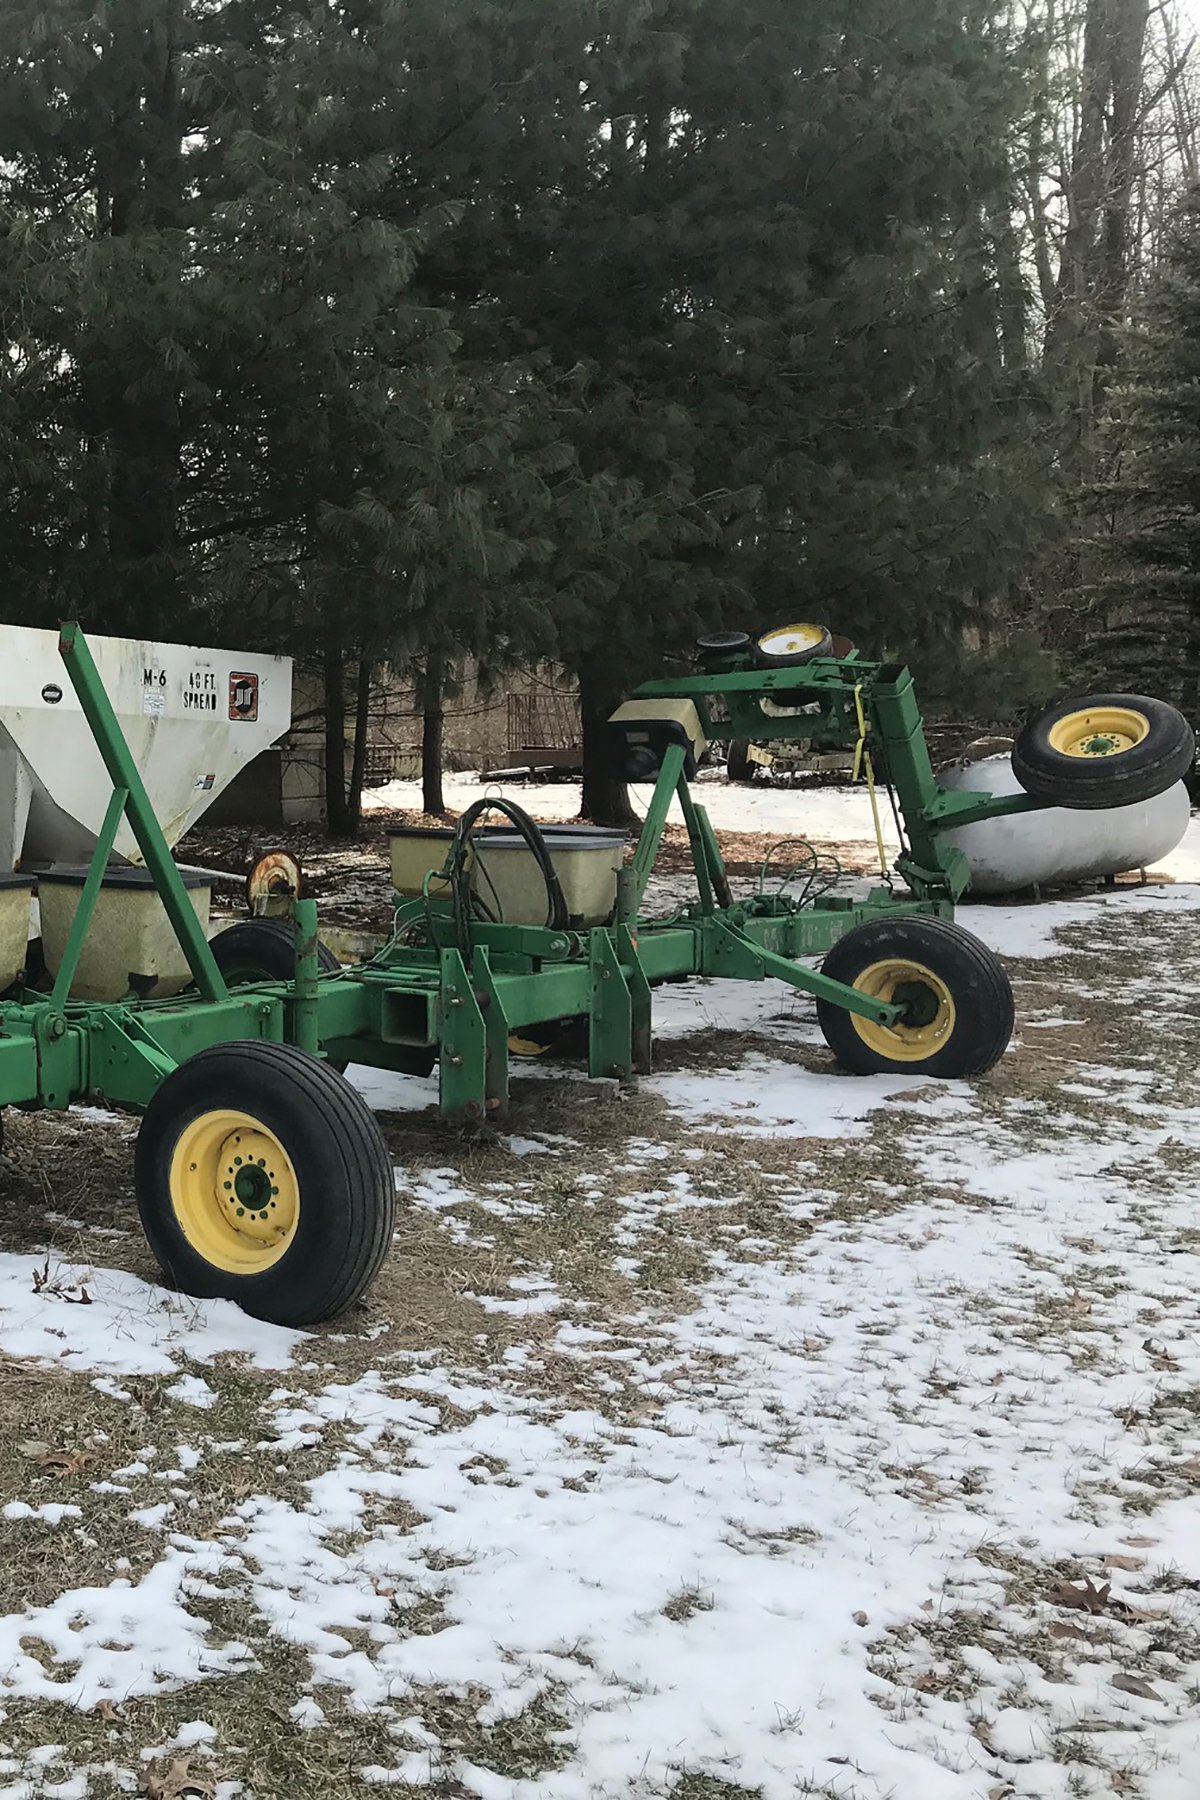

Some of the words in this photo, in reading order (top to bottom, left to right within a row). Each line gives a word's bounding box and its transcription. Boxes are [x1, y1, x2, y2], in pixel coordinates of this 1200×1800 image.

[143, 668, 167, 687] M-6
[189, 672, 201, 689] 40
[183, 691, 217, 711] SPREAD
